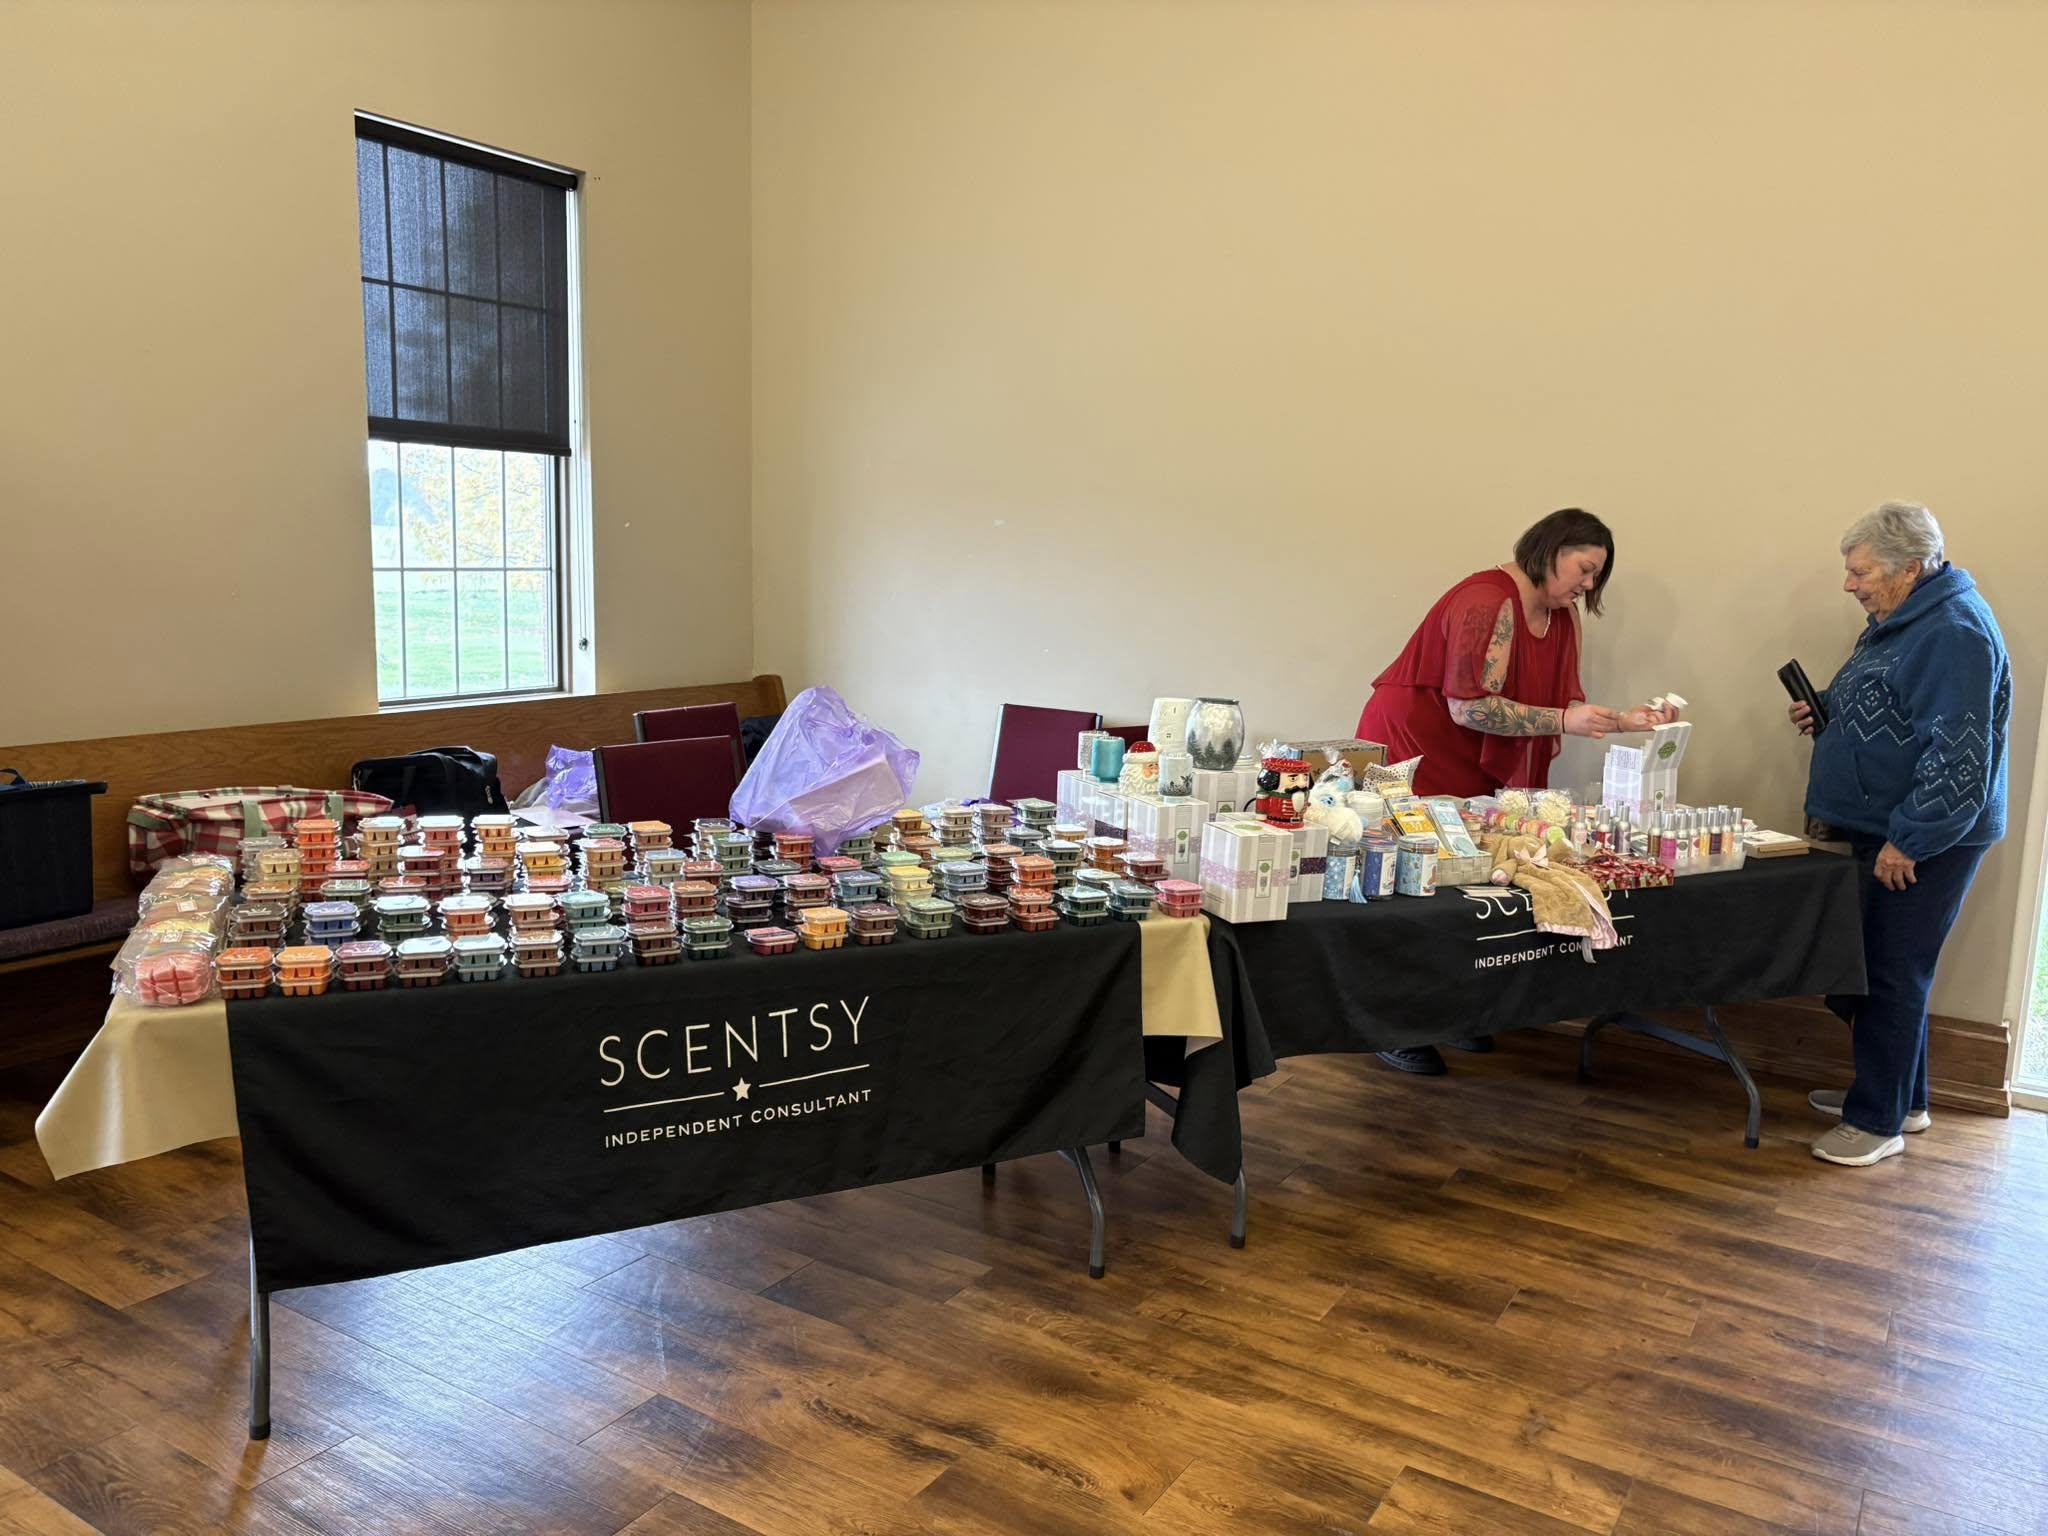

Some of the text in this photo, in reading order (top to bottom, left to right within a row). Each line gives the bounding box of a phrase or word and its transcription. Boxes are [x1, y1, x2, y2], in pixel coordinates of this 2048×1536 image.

[1474, 944, 1555, 970] INDEPENDENT
[598, 995, 870, 1087] SCENTSY
[604, 1088, 873, 1149] INDEPENDENT CONSULTANT
